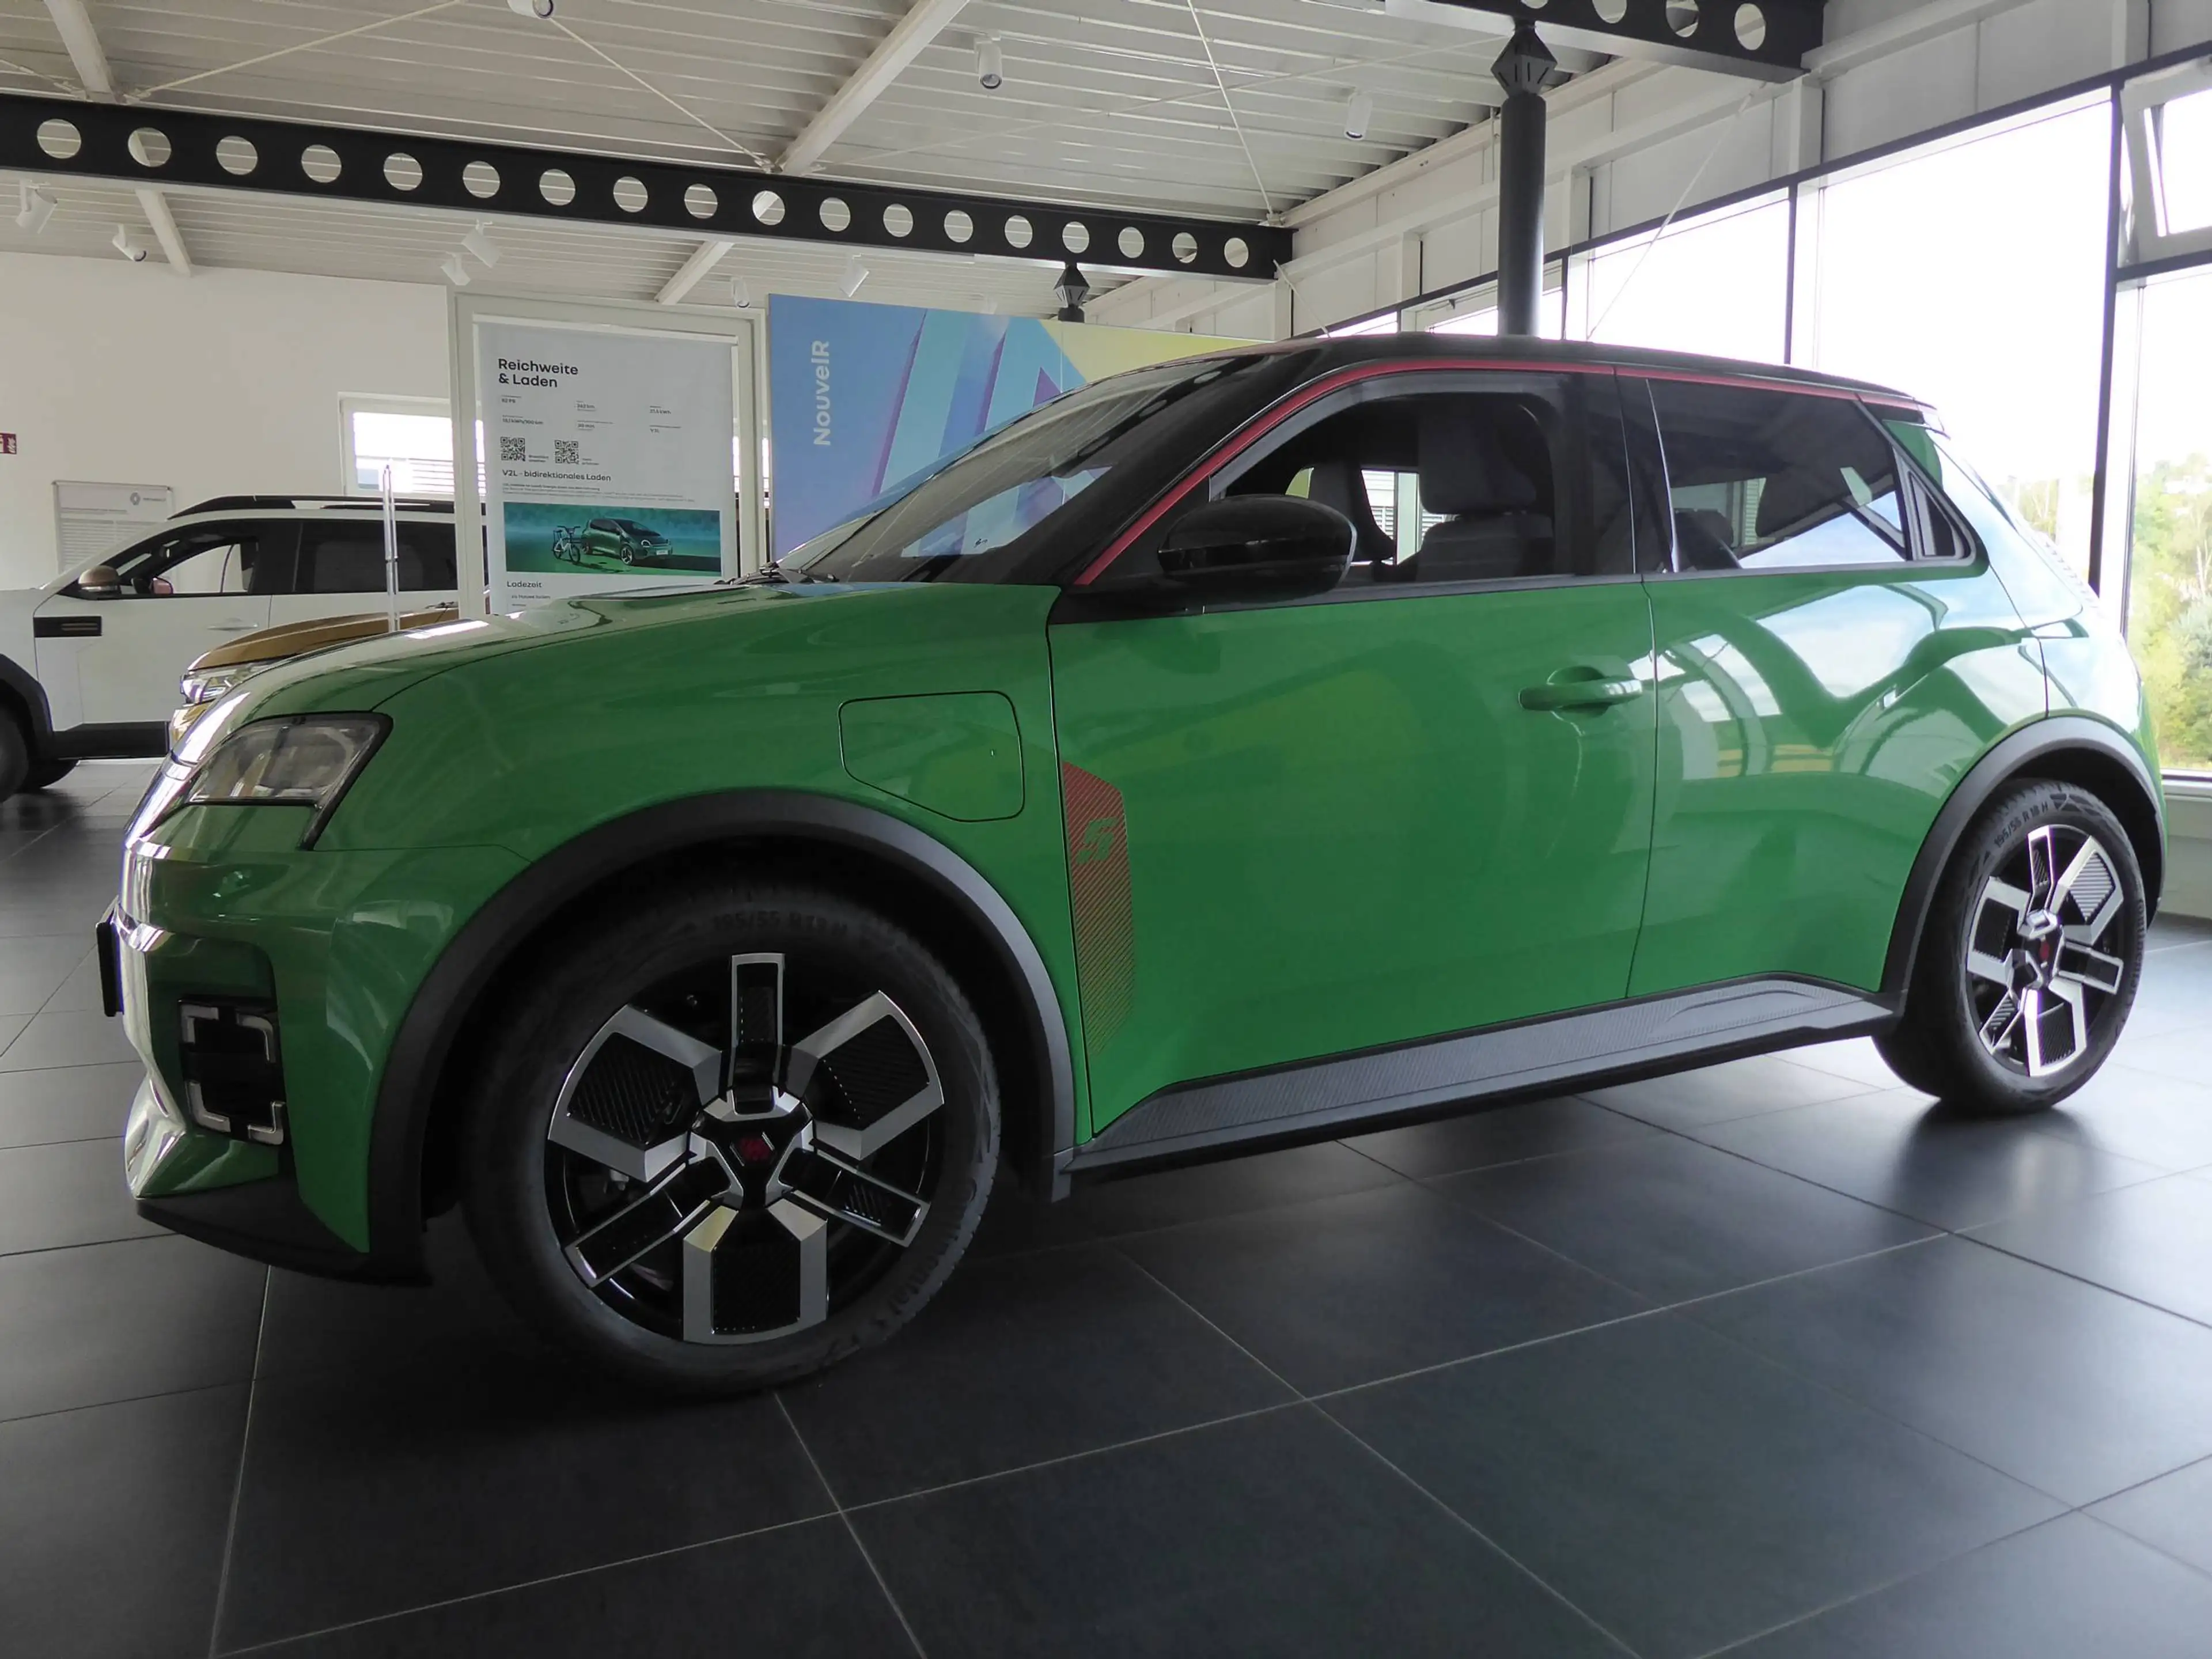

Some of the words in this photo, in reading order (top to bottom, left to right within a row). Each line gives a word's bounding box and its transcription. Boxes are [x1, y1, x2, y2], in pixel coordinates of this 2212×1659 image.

[498, 358, 578, 375] Reichweite
[499, 373, 509, 384] &
[513, 373, 558, 388] Laden
[810, 340, 831, 446] NouvelR
[502, 469, 518, 477] V2L
[524, 470, 585, 480] bidirektionales
[586, 473, 611, 482] Laden
[506, 580, 542, 588] Ladezeit
